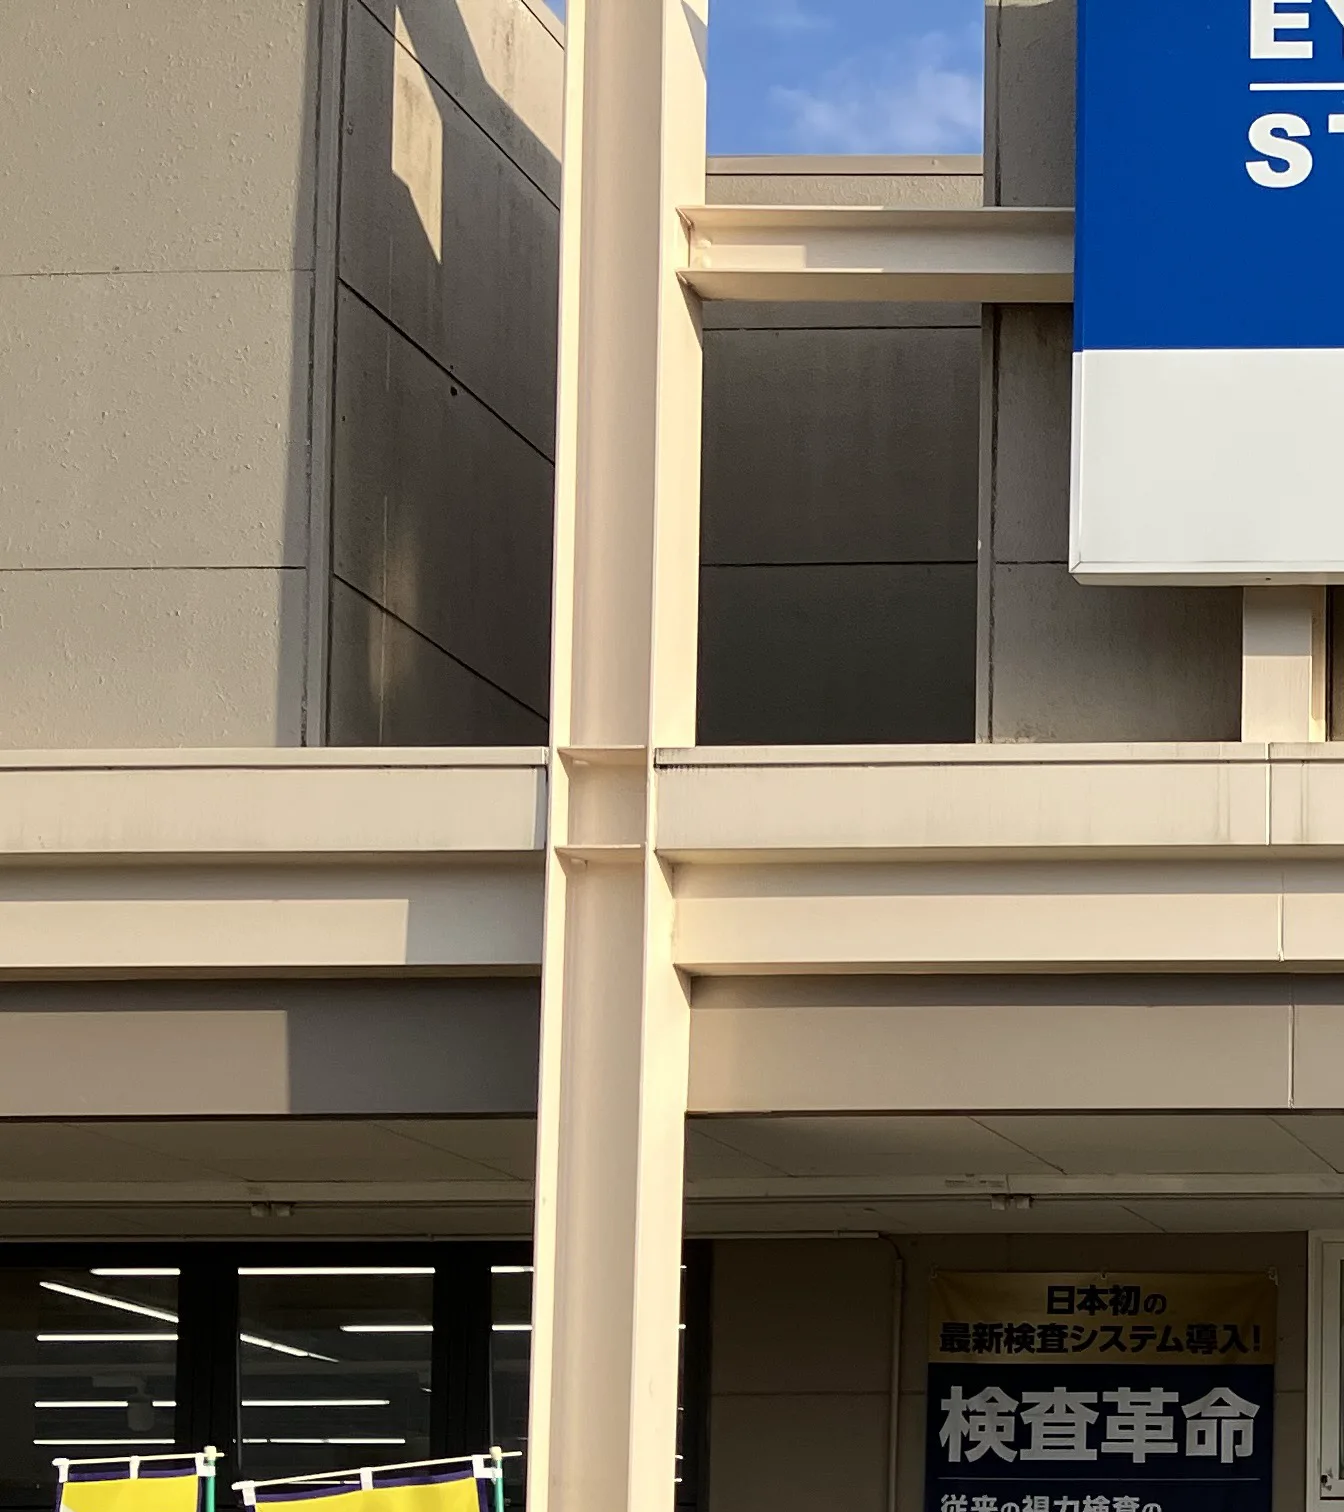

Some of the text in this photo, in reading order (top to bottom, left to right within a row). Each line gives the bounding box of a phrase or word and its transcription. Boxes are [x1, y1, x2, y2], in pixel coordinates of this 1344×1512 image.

[1046, 1284, 1167, 1317] 日本初の
[938, 1322, 1262, 1355] 最新検査システム導入!
[938, 1385, 1262, 1464] 検査革命
